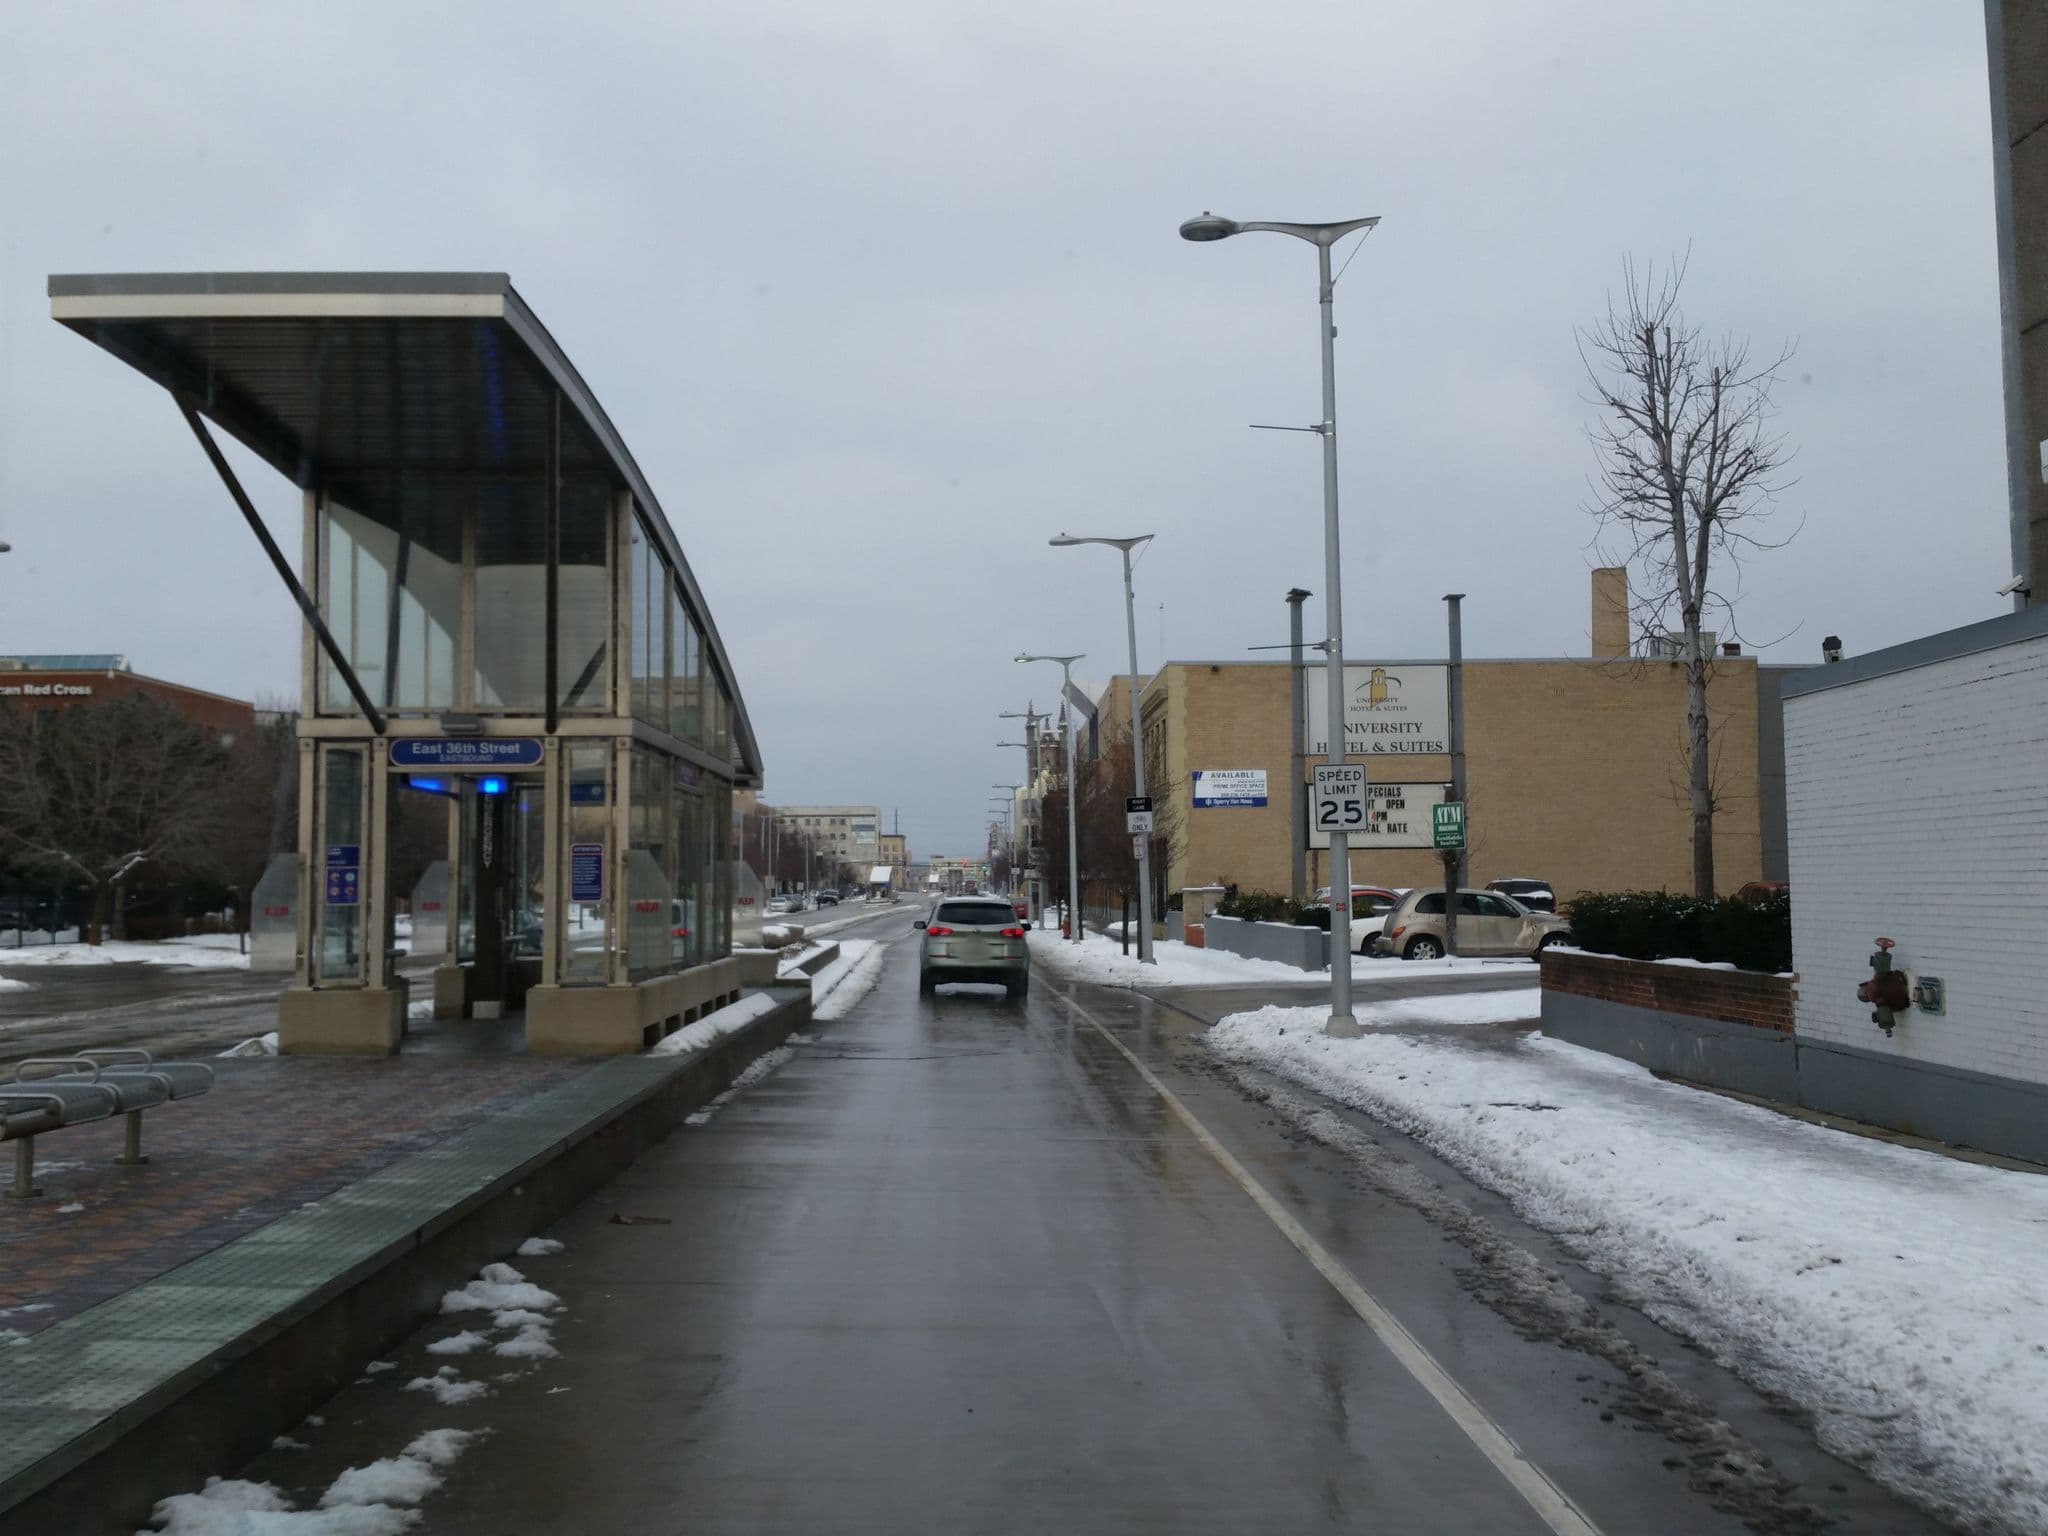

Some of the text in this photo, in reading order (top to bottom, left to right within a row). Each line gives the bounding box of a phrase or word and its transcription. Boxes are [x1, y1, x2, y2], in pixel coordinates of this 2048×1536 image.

[23, 684, 51, 695] Red
[54, 684, 92, 695] Cross
[1344, 722, 1424, 734] NIVERSITY
[412, 743, 520, 754] East 36th Street
[1372, 742, 1385, 752] &
[1390, 741, 1443, 752] SUITES
[1318, 771, 1362, 782] SPEED
[1324, 785, 1358, 795] LIMIT
[1368, 787, 1402, 798] PECIALS
[1386, 800, 1405, 809] OPEN
[1320, 800, 1363, 825] 25
[1371, 811, 1388, 822] 4PM
[1435, 806, 1461, 823] ATM
[1387, 823, 1408, 833] RATE
